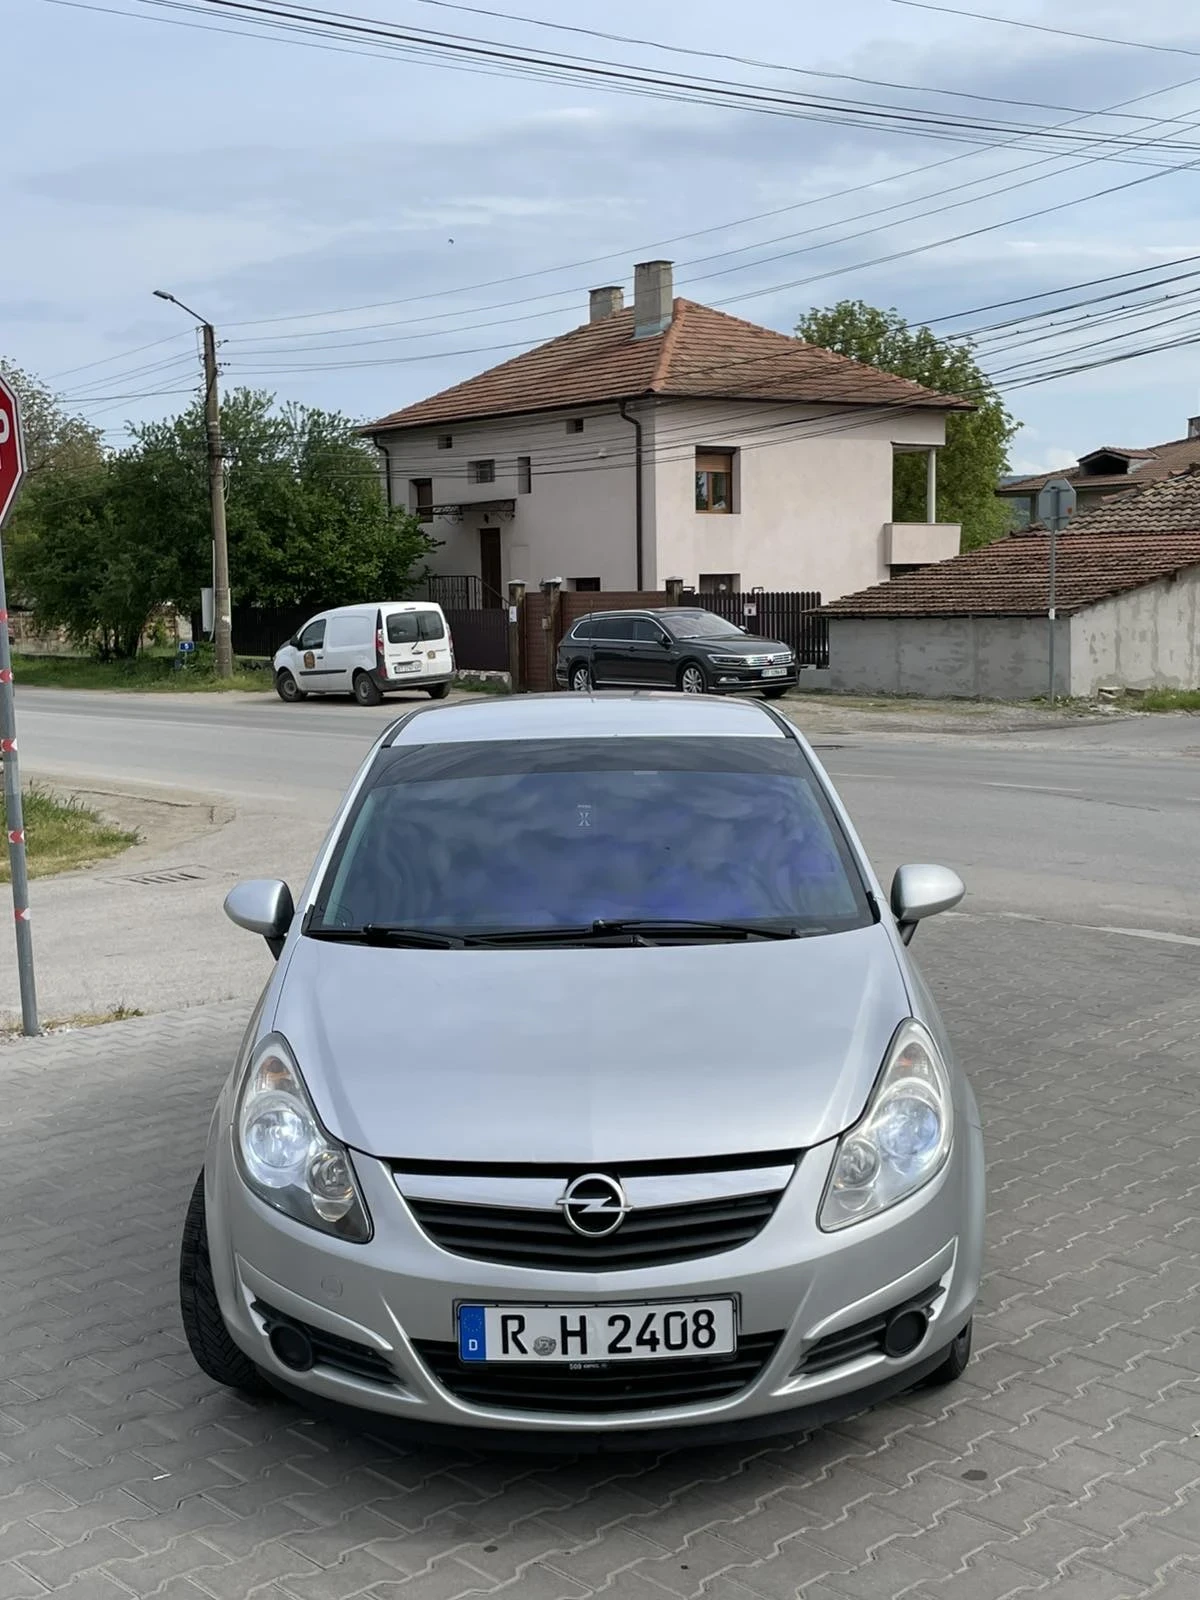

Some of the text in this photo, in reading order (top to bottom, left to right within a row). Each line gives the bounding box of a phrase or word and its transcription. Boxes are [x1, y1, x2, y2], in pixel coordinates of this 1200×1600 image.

[468, 1339, 478, 1351] D
[501, 1309, 716, 1355] R H 2408
